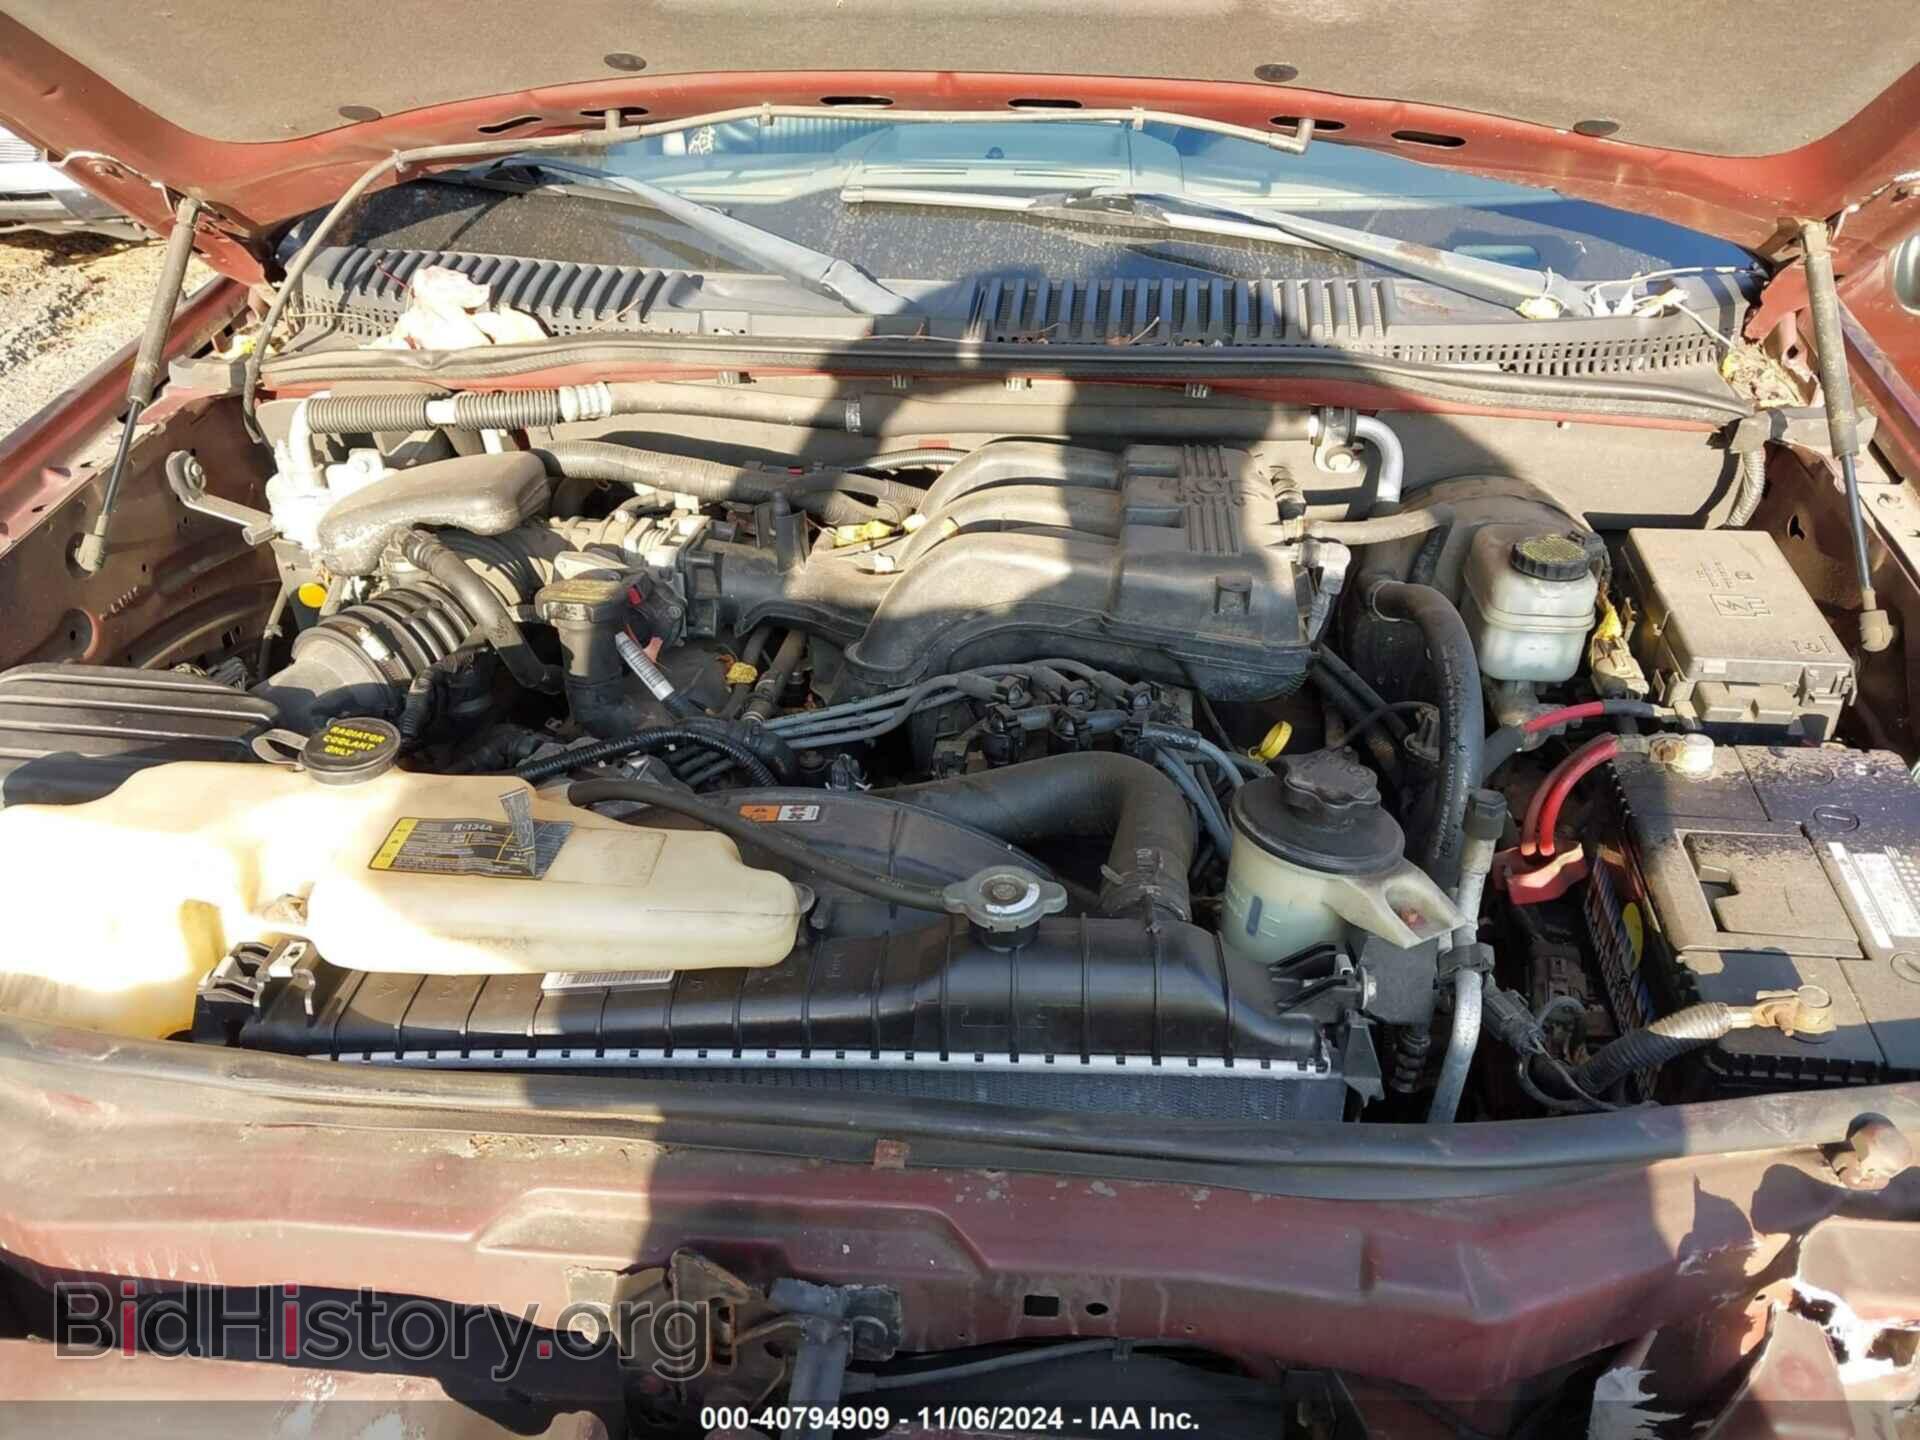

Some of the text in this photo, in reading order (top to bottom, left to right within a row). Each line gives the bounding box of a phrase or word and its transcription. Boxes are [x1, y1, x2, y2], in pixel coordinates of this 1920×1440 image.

[322, 734, 376, 751] COOLANT
[329, 725, 386, 744] RADIATOR
[323, 744, 355, 757] ONLY
